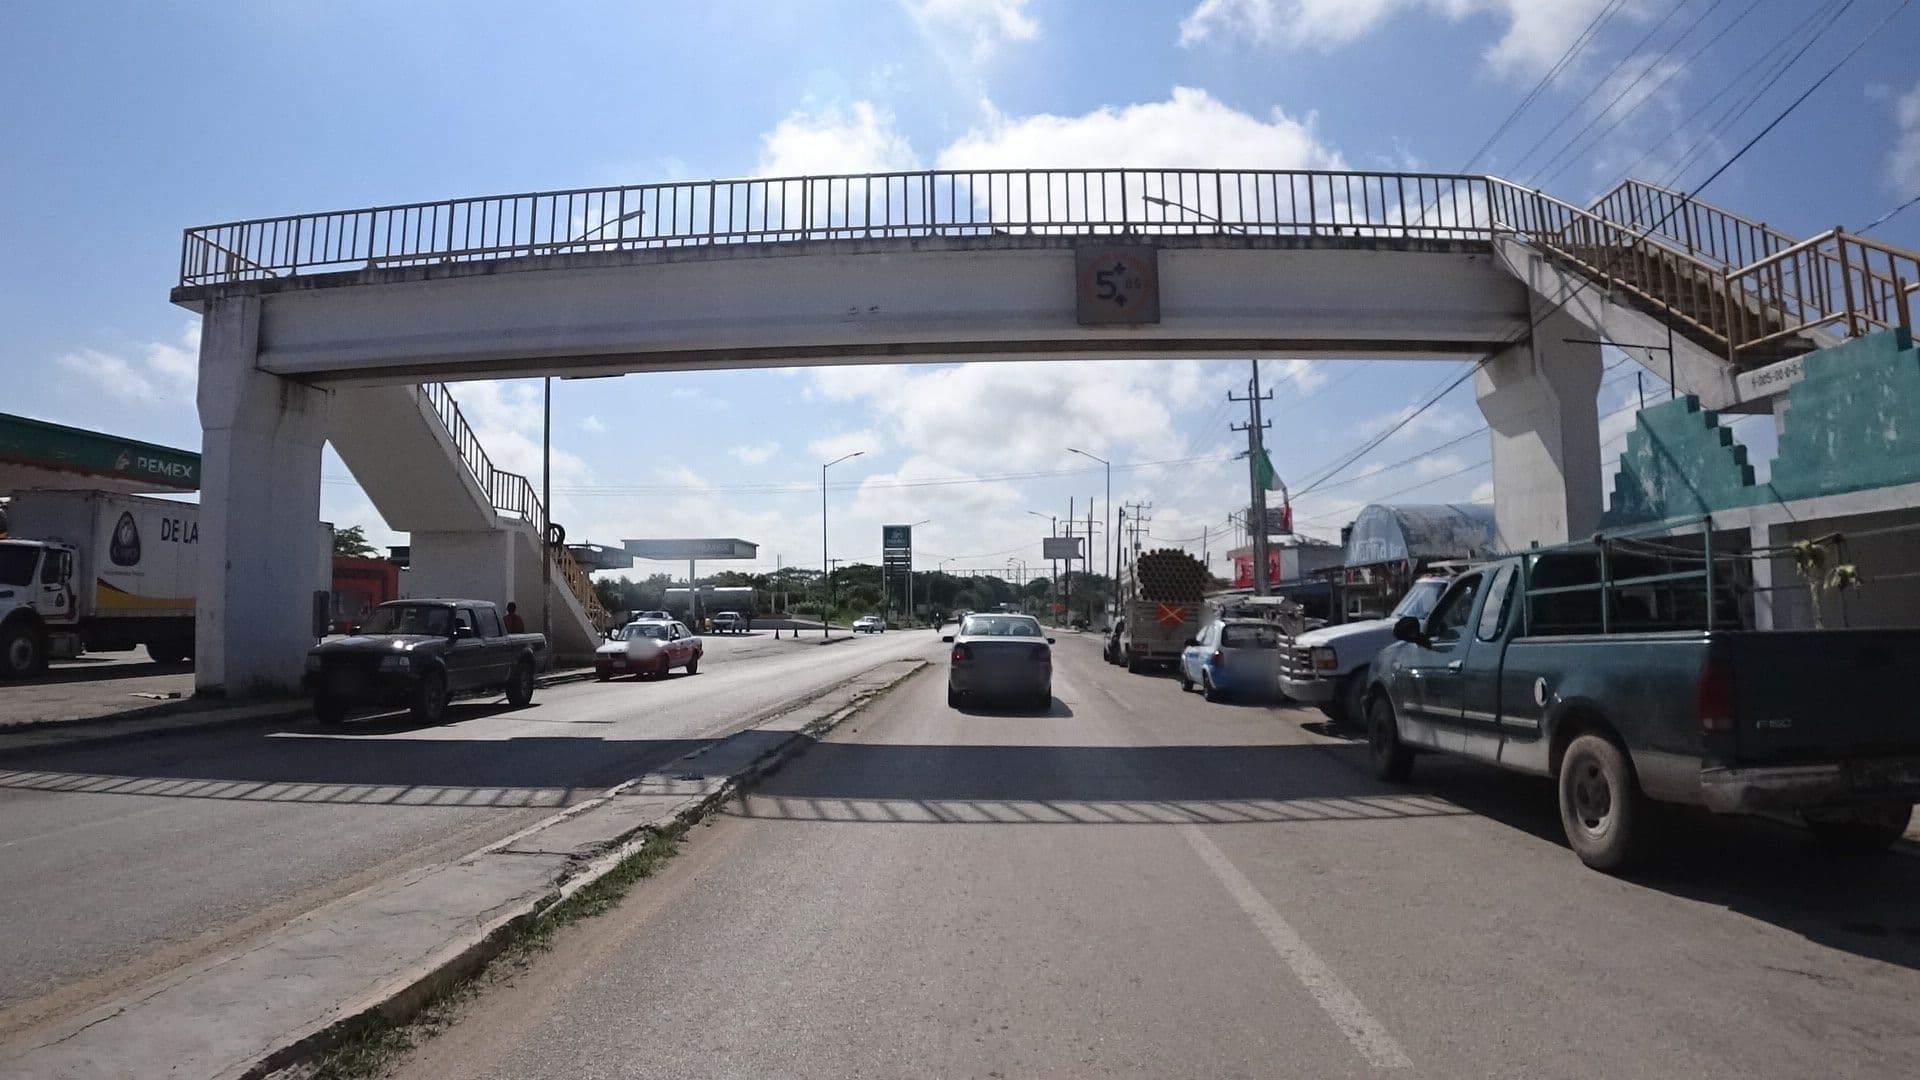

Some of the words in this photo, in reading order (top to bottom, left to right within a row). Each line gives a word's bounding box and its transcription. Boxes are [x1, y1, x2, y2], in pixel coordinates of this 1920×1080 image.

[1096, 271, 1117, 300] 5
[137, 456, 193, 478] PEMEX
[160, 518, 180, 543] DE
[183, 520, 199, 545] LA
